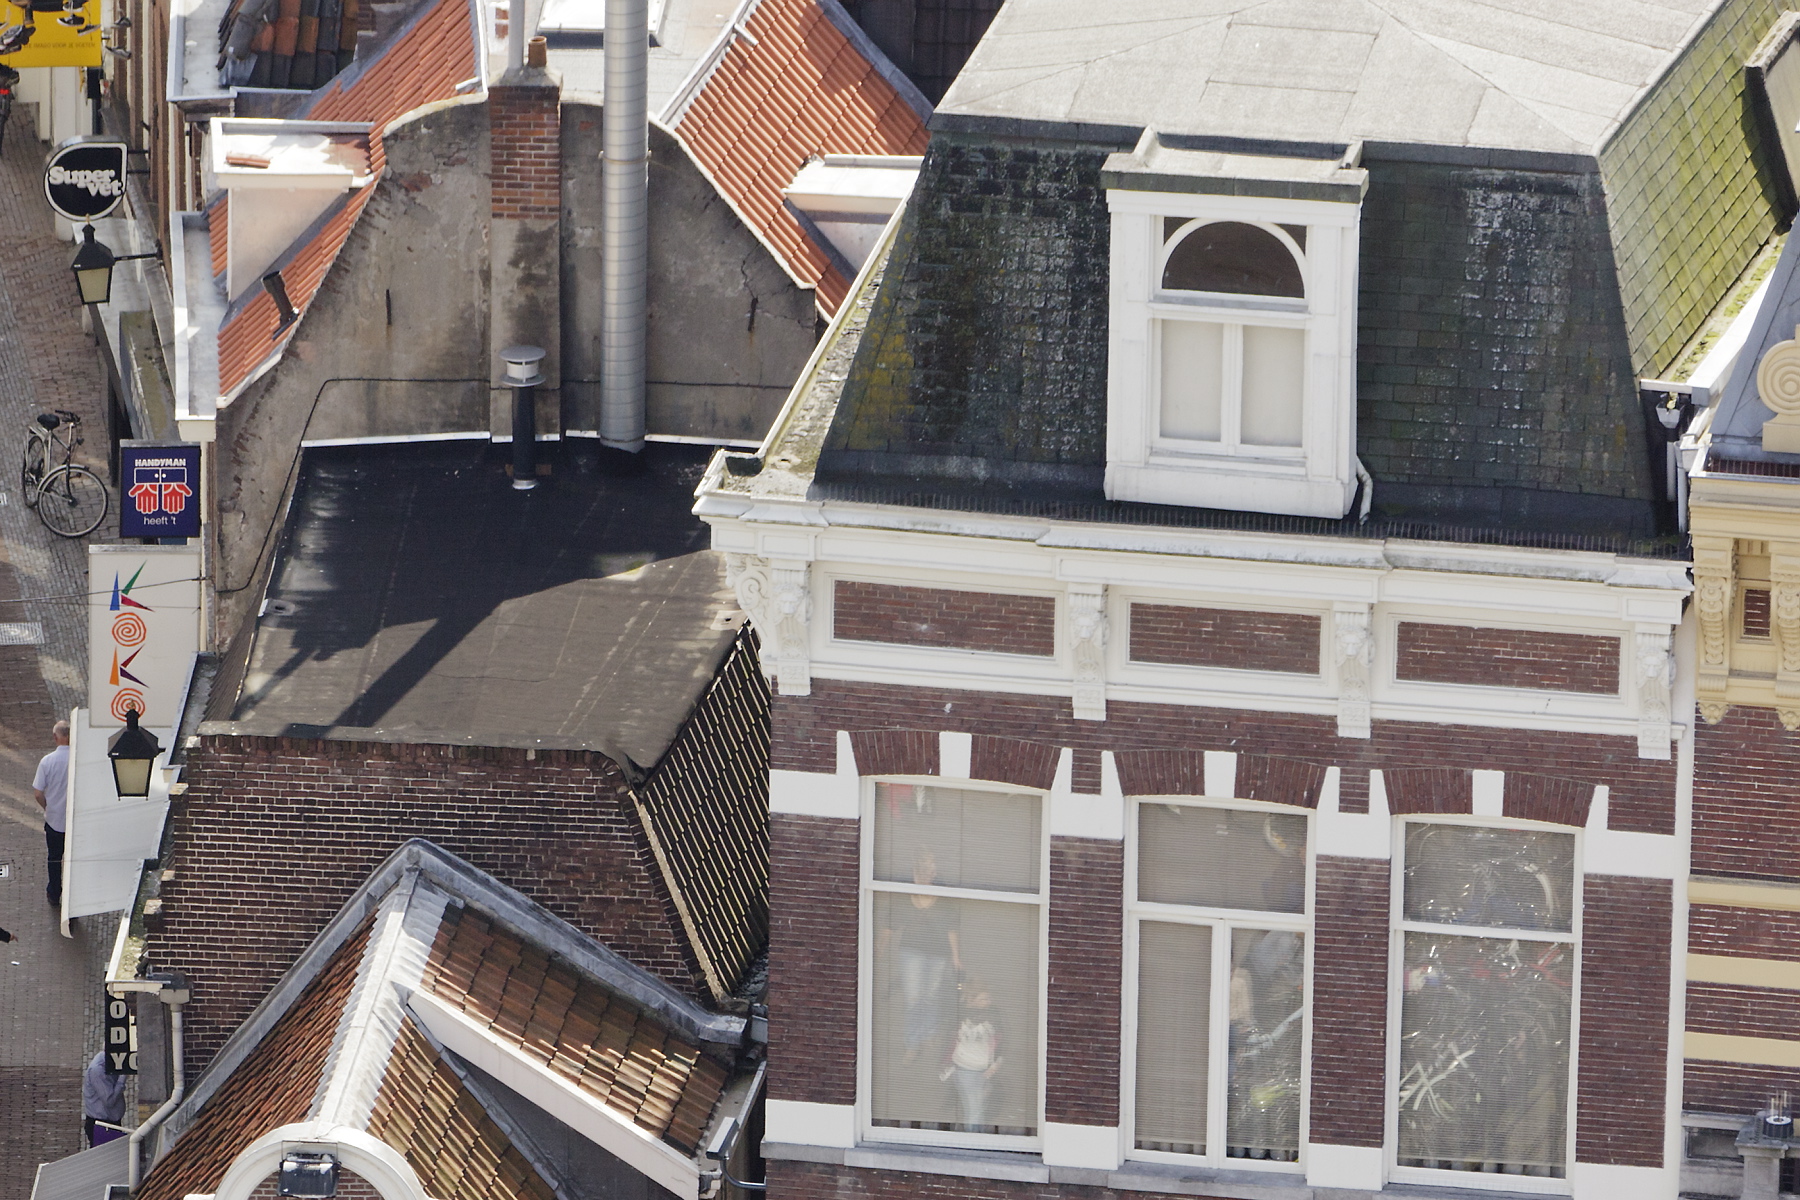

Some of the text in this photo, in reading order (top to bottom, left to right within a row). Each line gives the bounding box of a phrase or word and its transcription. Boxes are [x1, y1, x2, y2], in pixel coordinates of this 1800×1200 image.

[49, 165, 115, 188] Super
[86, 179, 122, 197] vet
[134, 458, 186, 467] HANDYMAN
[143, 516, 168, 525] heeft
